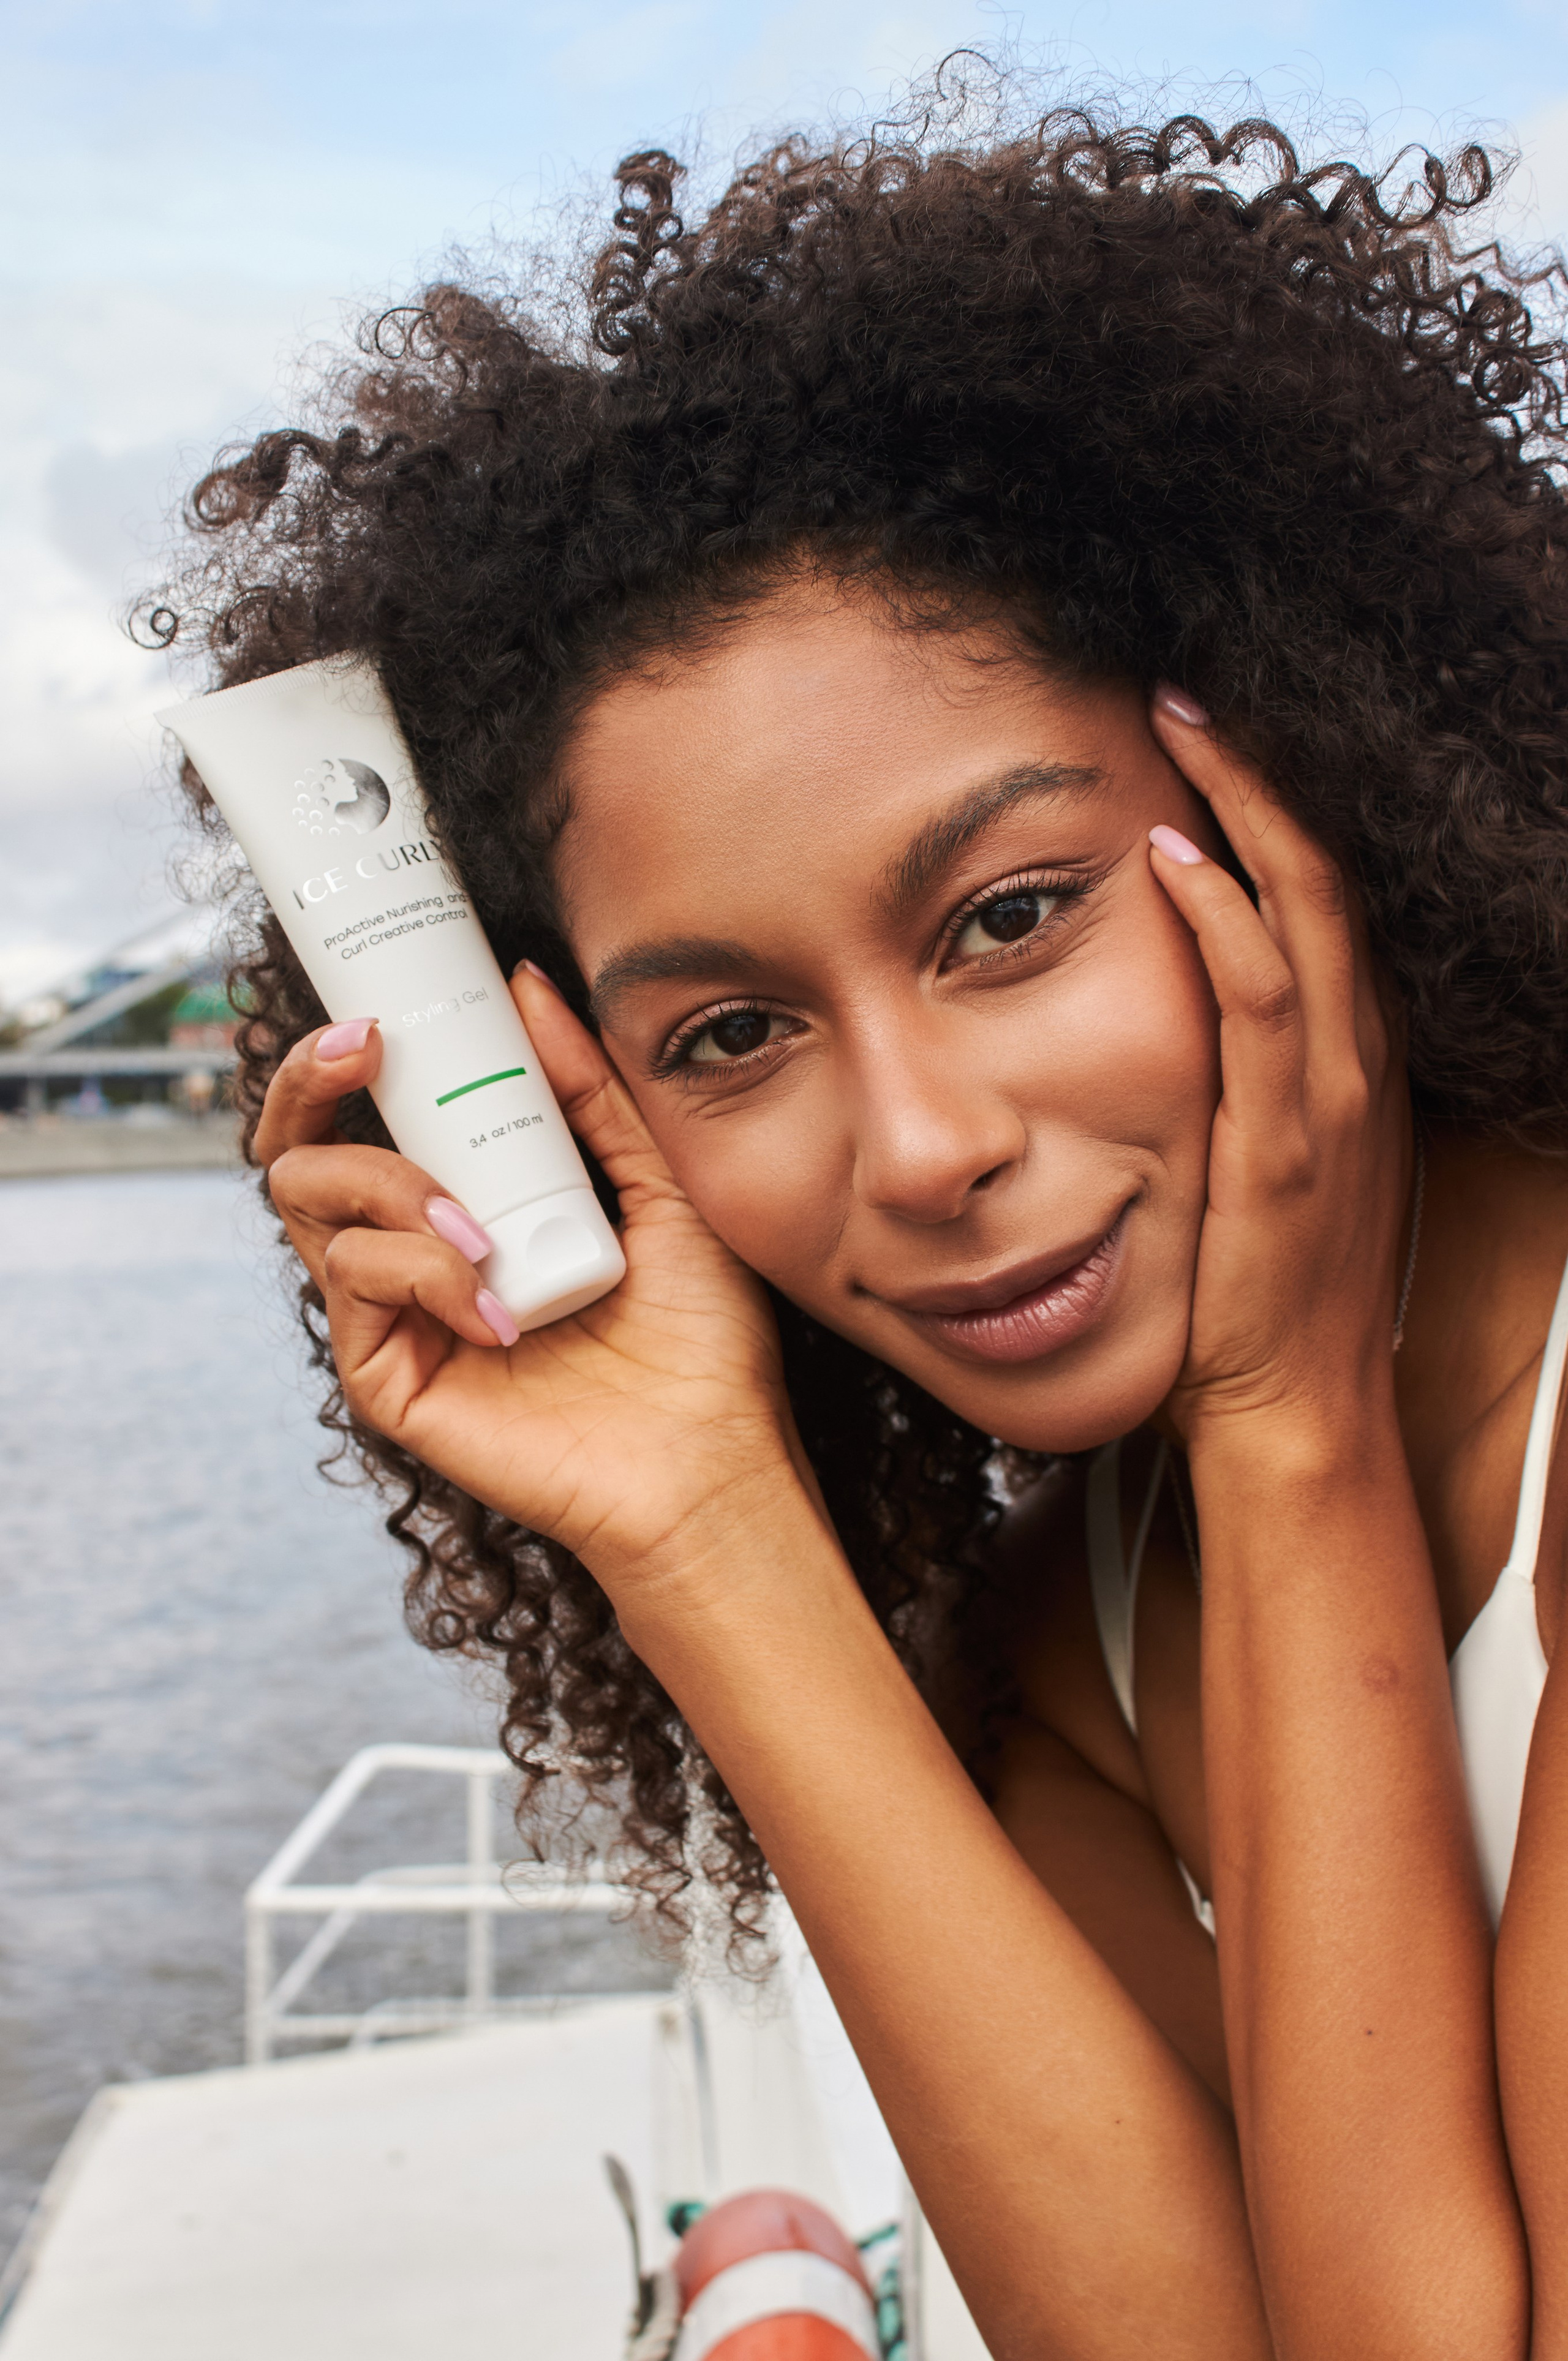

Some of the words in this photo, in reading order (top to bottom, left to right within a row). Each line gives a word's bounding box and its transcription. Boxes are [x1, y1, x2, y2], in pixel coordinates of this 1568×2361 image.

[293, 867, 348, 910] ICE
[324, 916, 385, 949] ProActive
[387, 894, 443, 919] Nurishing
[341, 941, 368, 959] Curl
[369, 920, 424, 945] Creative
[426, 908, 468, 925] Control
[402, 999, 460, 1027] Styling
[462, 987, 489, 1004] Gel
[492, 1128, 506, 1138] oz
[513, 1118, 530, 1129] 100
[532, 1113, 544, 1124] ml
